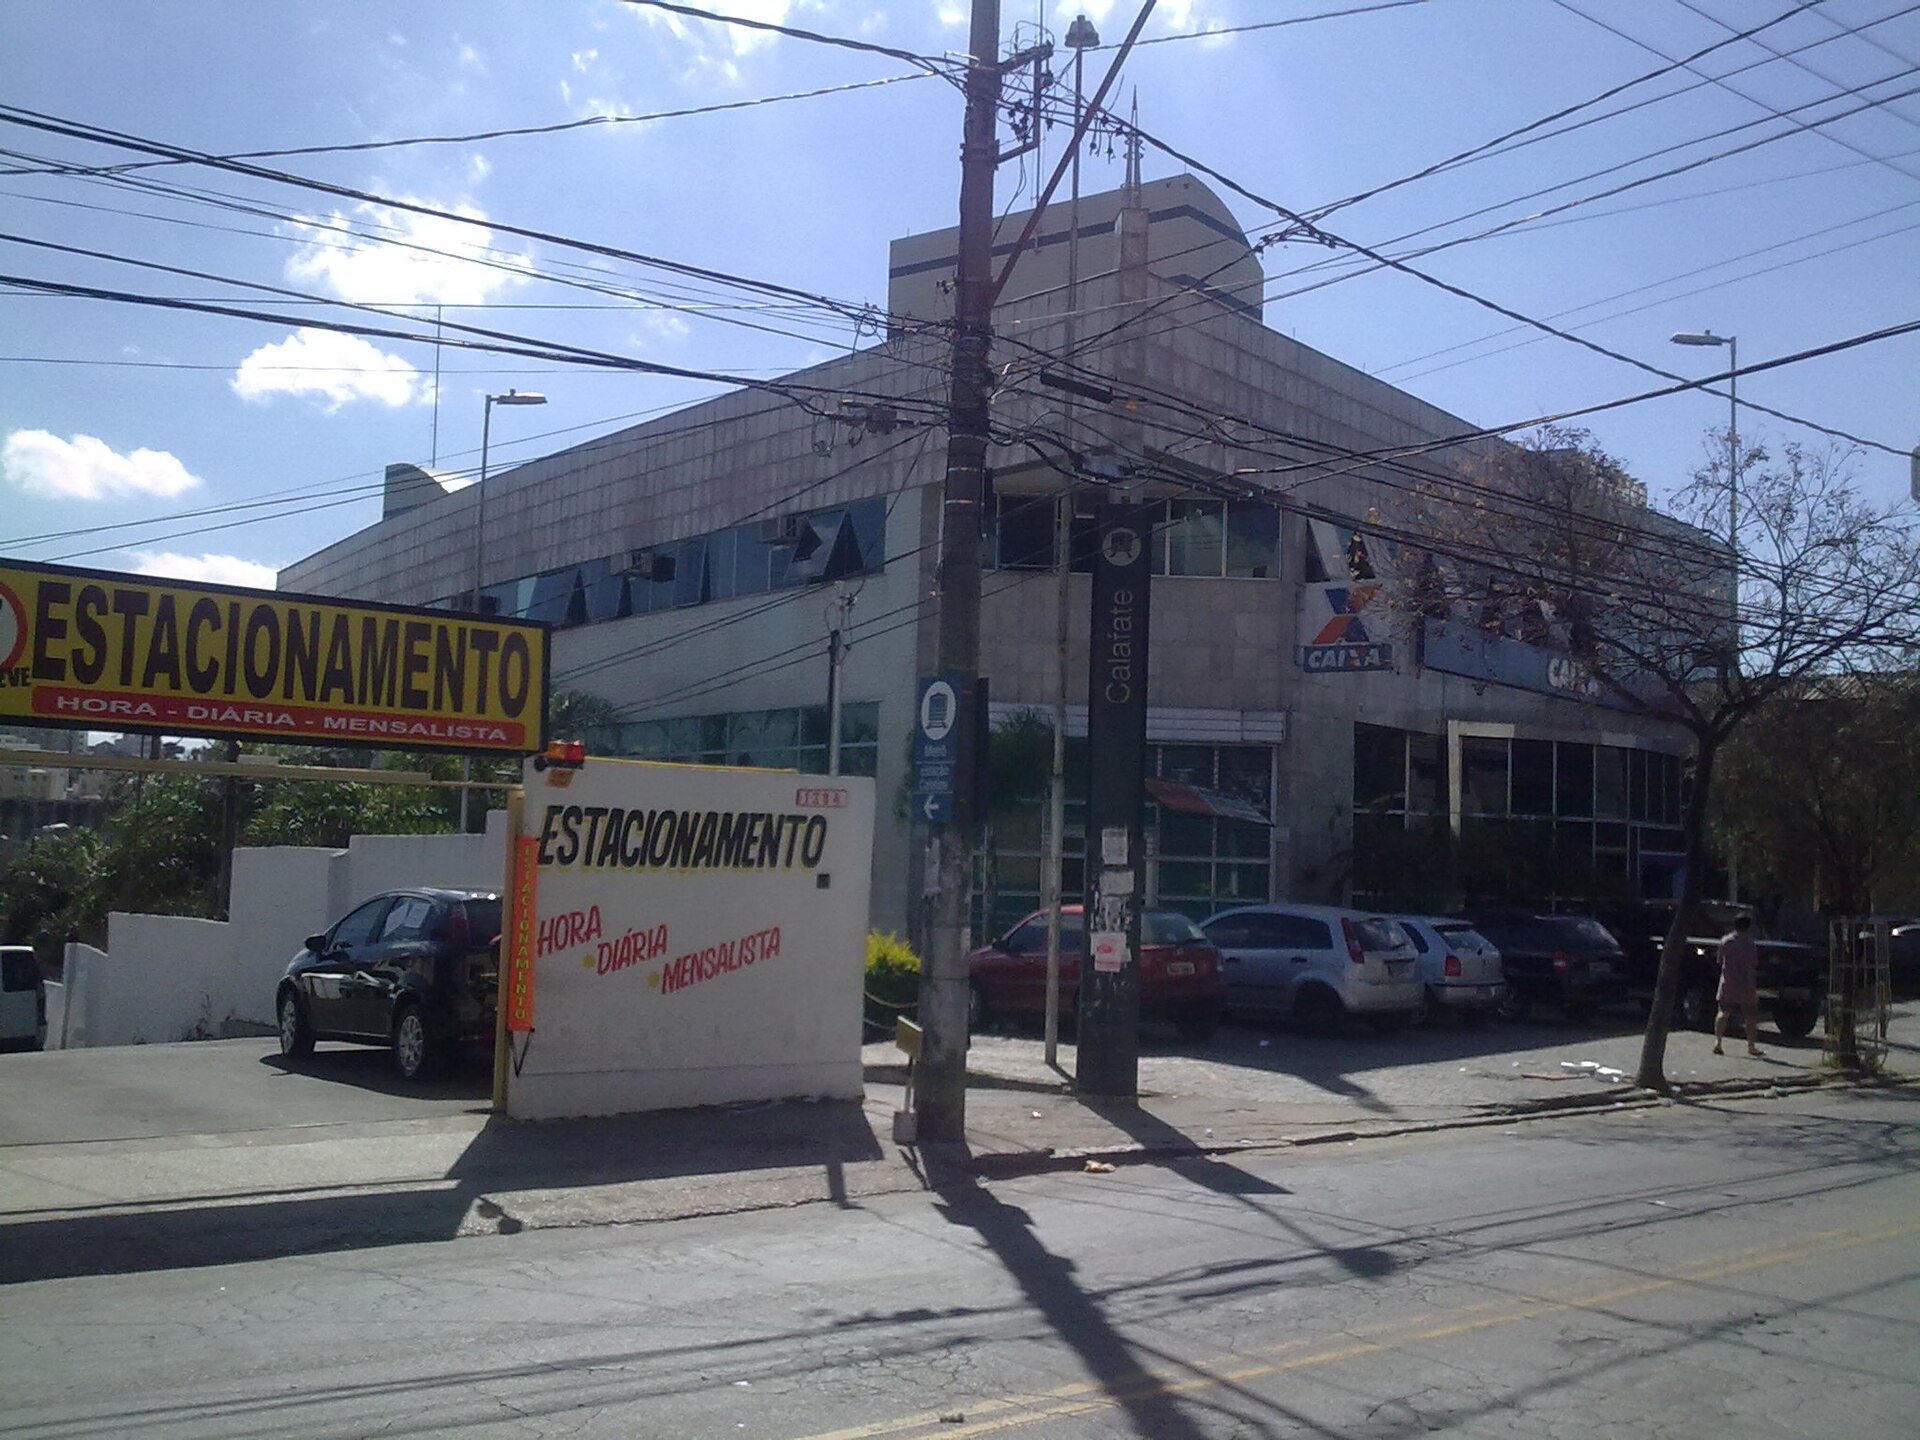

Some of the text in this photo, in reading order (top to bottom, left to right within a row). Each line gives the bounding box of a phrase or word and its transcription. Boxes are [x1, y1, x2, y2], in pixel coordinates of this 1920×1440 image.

[32, 581, 530, 718] ESTACIONAMENTO
[1105, 588, 1133, 705] Calafate
[1308, 648, 1382, 668] CAIXA
[57, 695, 157, 717] HORA
[187, 703, 297, 728] DIÁRIA
[323, 716, 508, 741] MENSALISTA
[537, 805, 828, 868] ESTACIONAMENTO
[536, 905, 602, 958] HORA
[596, 924, 668, 976] DIÁRIA
[662, 926, 781, 995] MENSALISTA
